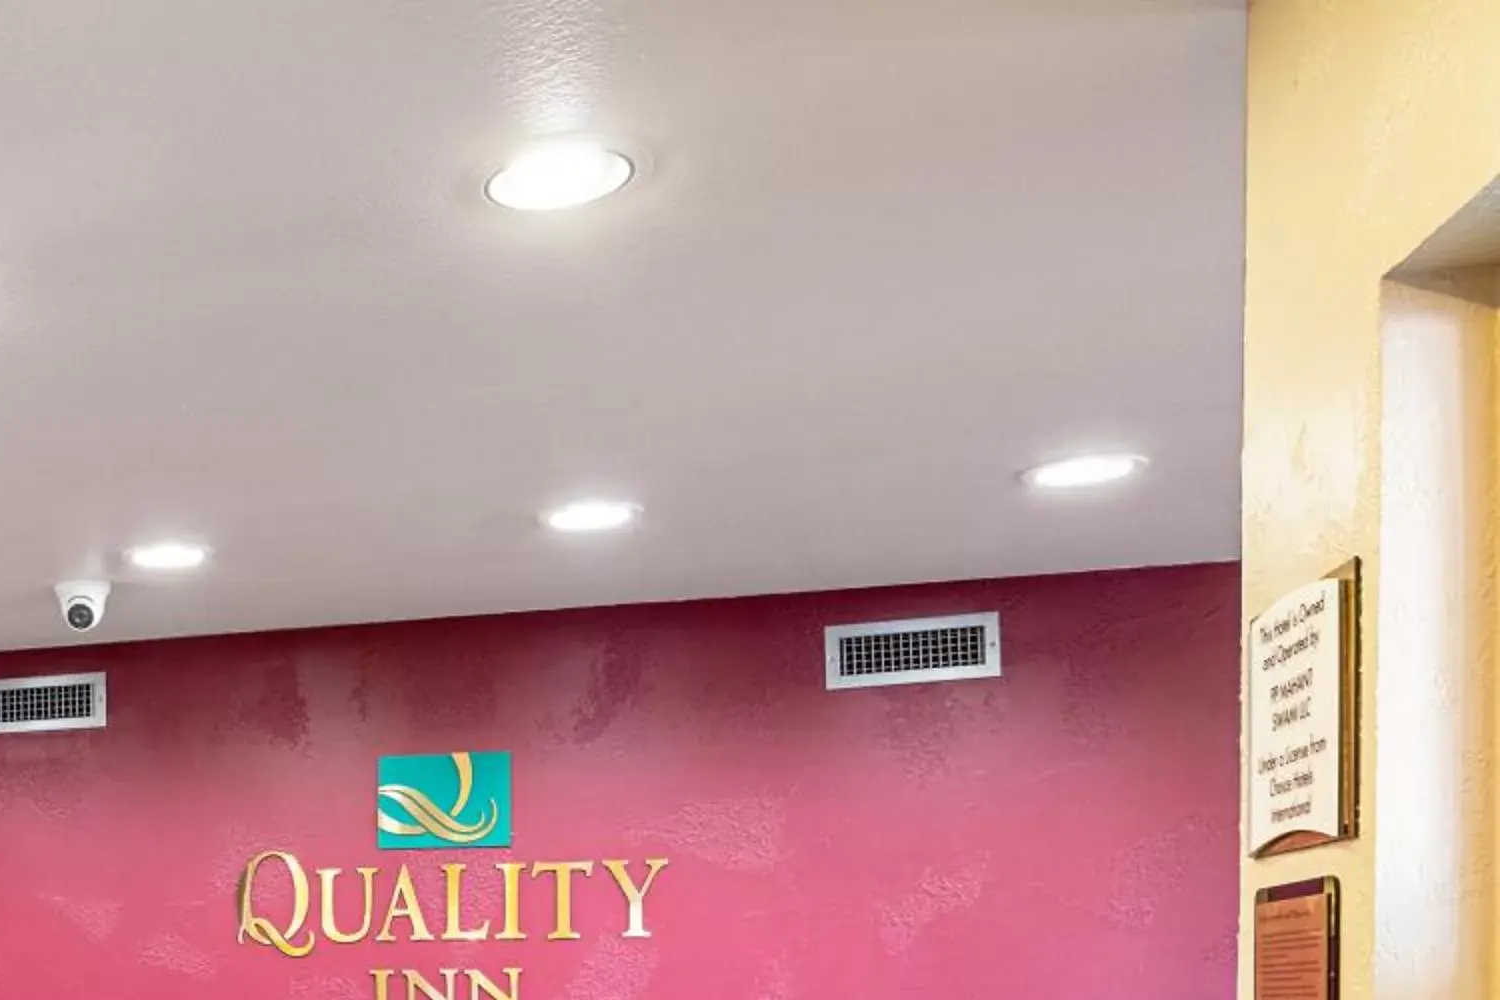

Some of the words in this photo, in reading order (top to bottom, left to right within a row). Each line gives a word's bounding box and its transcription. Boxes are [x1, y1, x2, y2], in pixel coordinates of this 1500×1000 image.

[1273, 609, 1290, 637] Hotel
[1299, 589, 1326, 623] Owned
[1262, 645, 1277, 672] and
[1277, 629, 1309, 667] Operated
[1309, 732, 1327, 755] from
[237, 849, 669, 957] QUALITY
